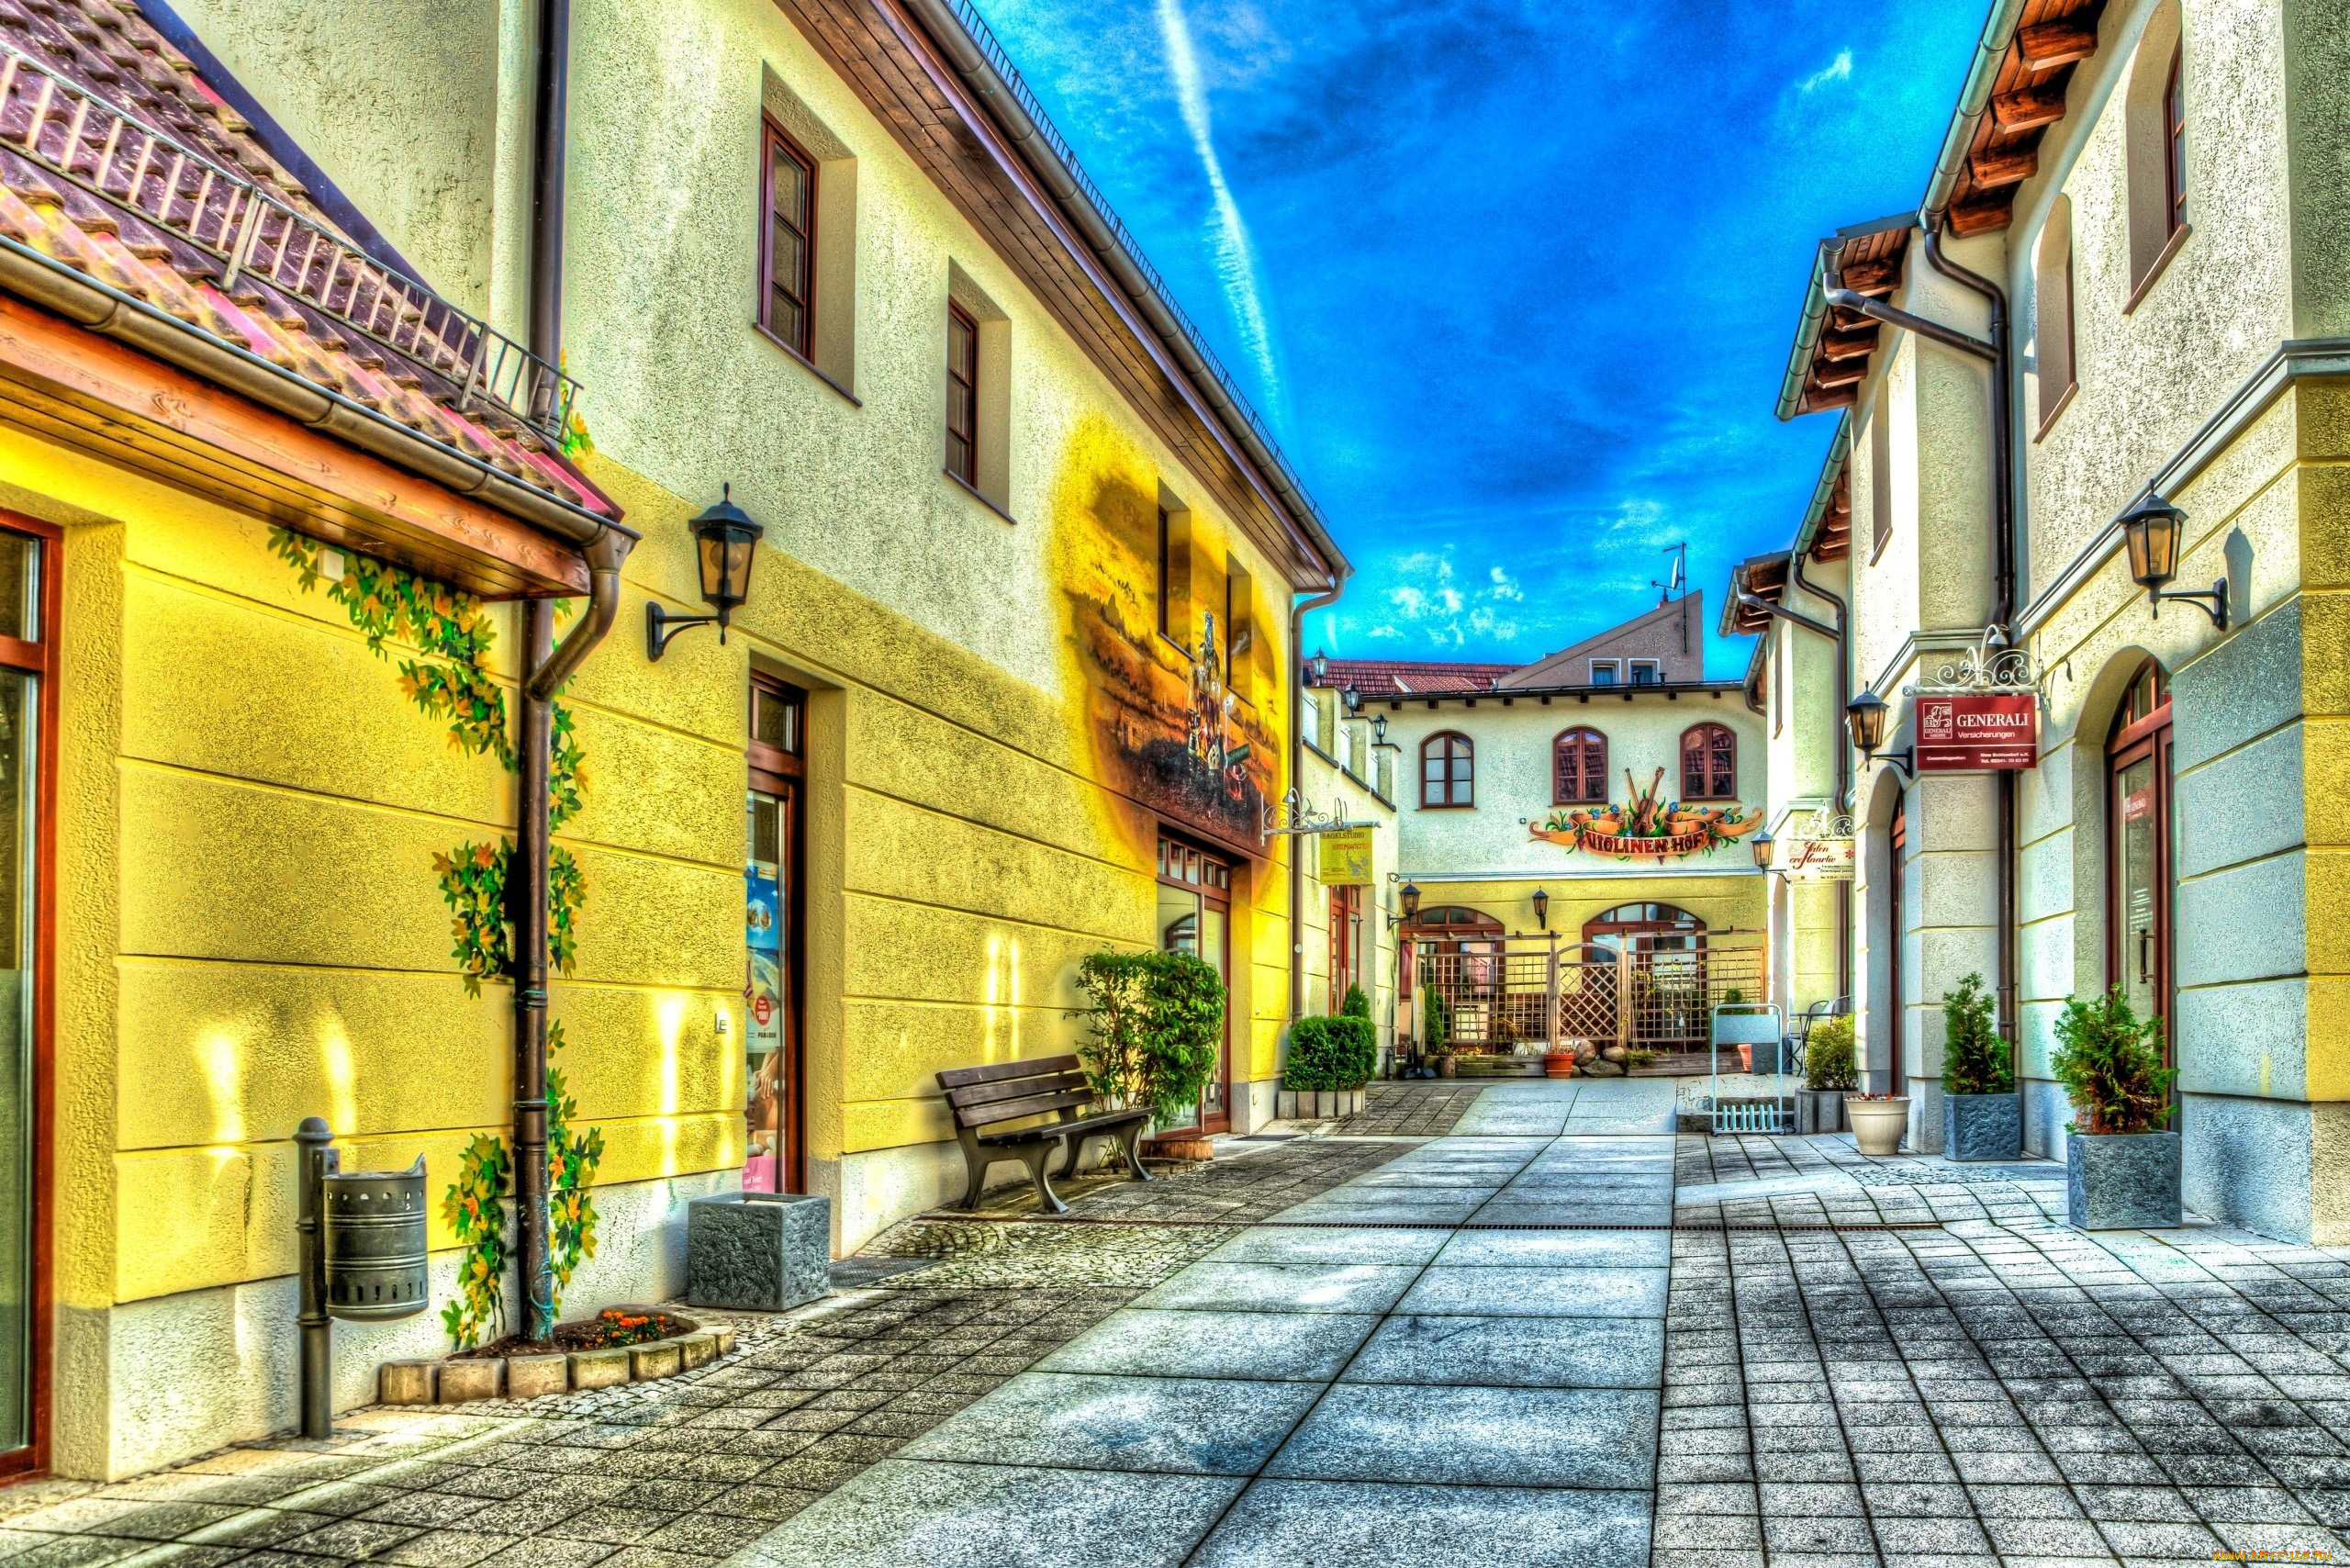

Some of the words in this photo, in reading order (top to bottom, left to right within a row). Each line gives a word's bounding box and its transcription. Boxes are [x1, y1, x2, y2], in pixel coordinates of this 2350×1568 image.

[1956, 713, 2029, 727] GENERALI
[1958, 731, 2015, 739] Versicherungen
[1585, 831, 1669, 854] VIOLINEN
[1671, 832, 1706, 852] HOF
